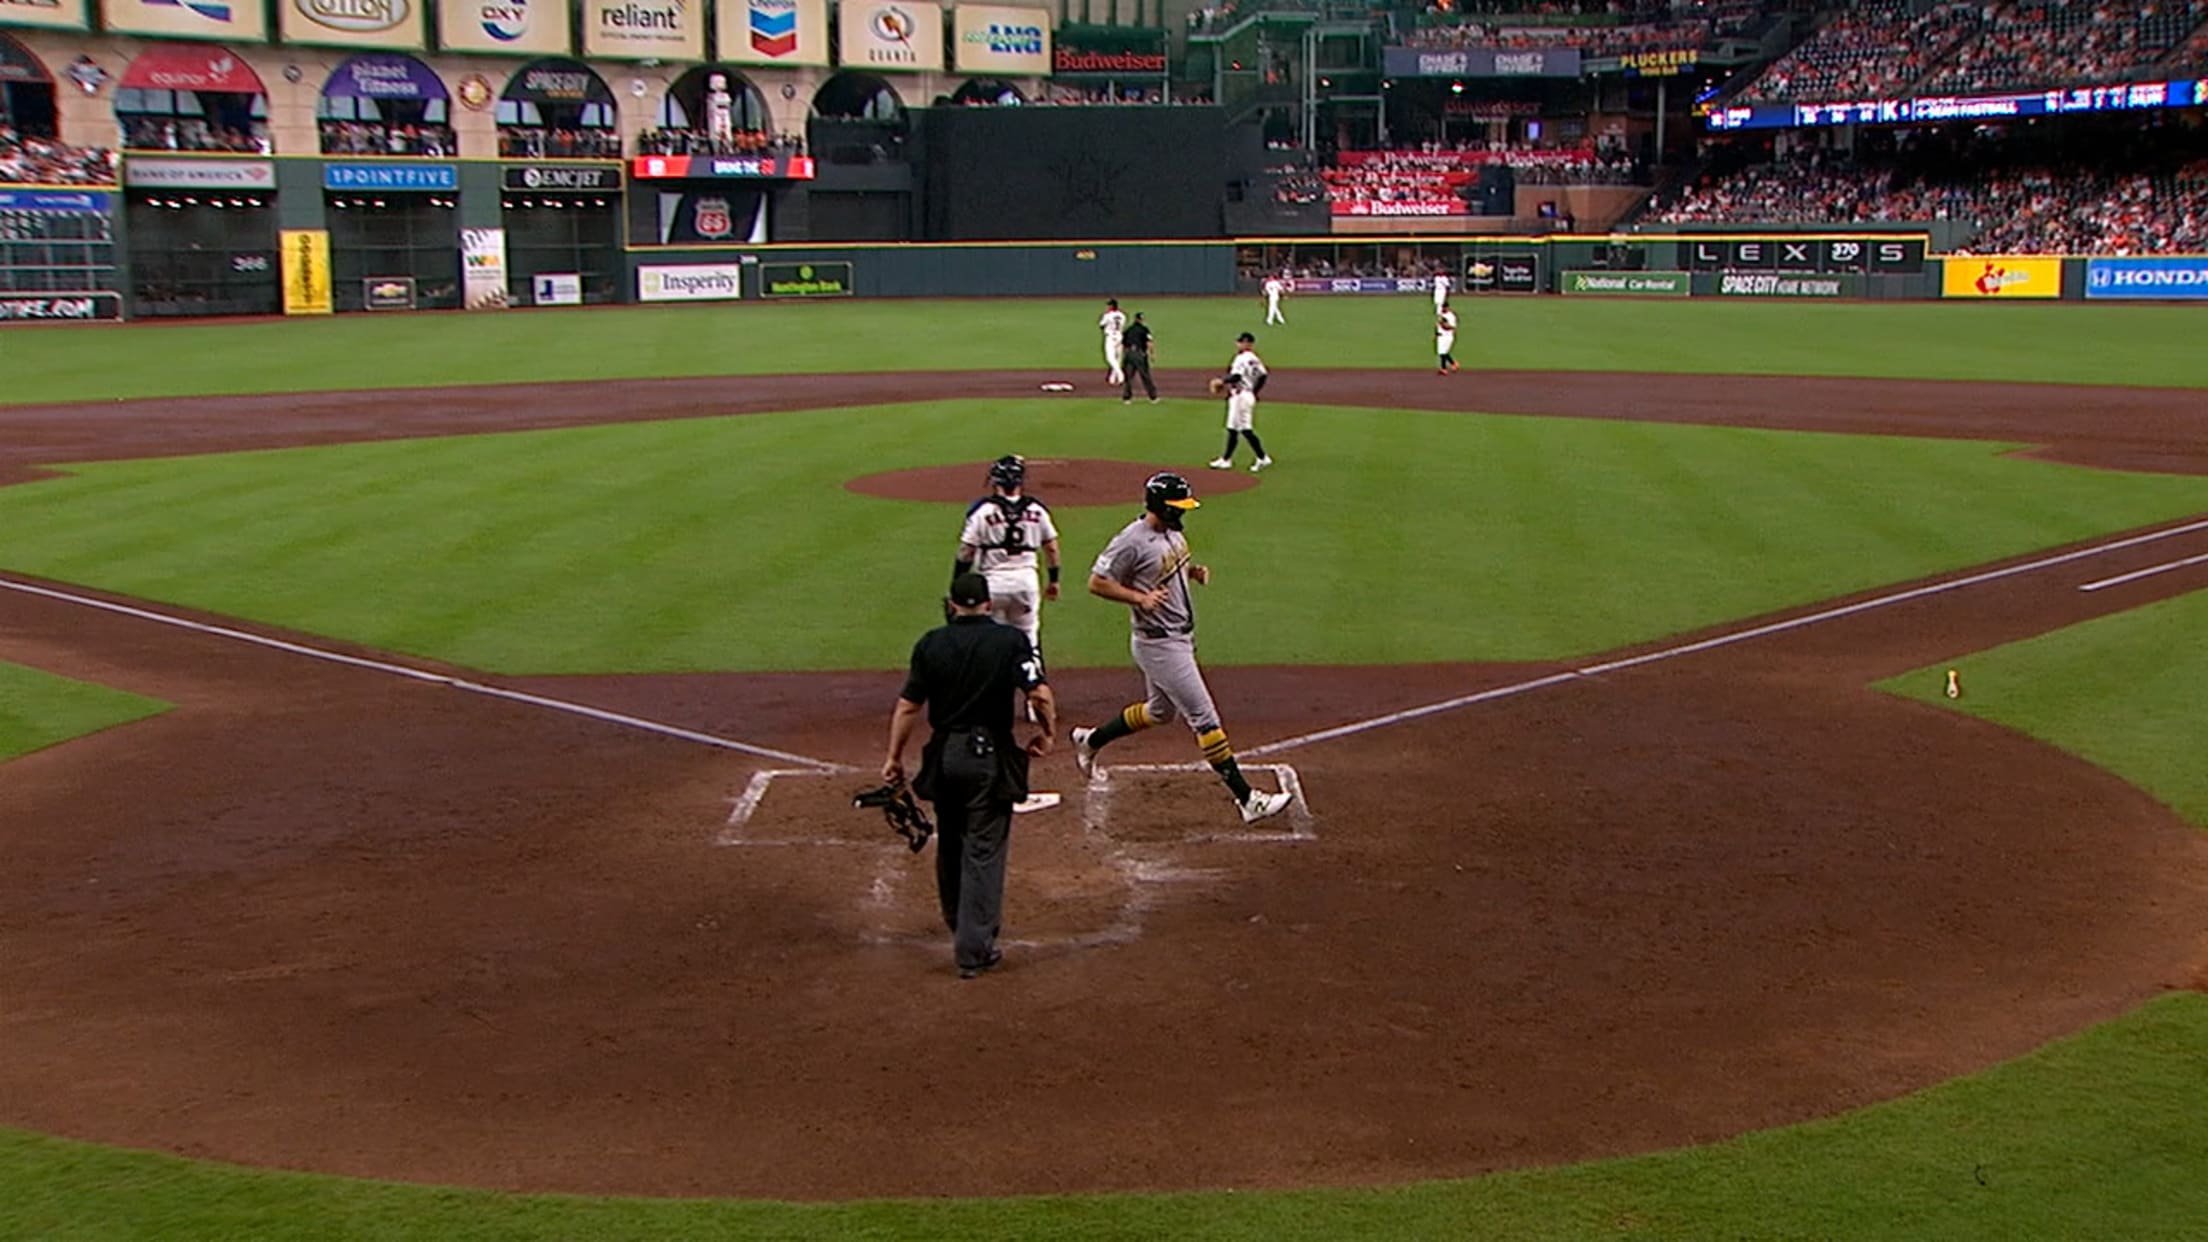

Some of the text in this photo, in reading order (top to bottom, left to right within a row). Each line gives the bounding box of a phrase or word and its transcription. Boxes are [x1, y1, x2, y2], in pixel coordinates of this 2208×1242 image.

[482, 6, 522, 21] OXY
[601, 7, 677, 29] reliant
[989, 25, 1042, 54] LNG
[1055, 50, 1165, 70] Budweiser
[1620, 49, 1697, 69] PLUCKERS
[132, 169, 166, 179] BANK
[187, 170, 243, 180] AMERICA
[1371, 200, 1449, 215] Budweiser
[703, 214, 727, 229] 66
[1832, 243, 1859, 256] 370
[662, 272, 735, 293] Insperity
[1587, 276, 1676, 290] National Car Rental
[1721, 275, 1755, 294] SPACE
[1755, 275, 1778, 293] CITY
